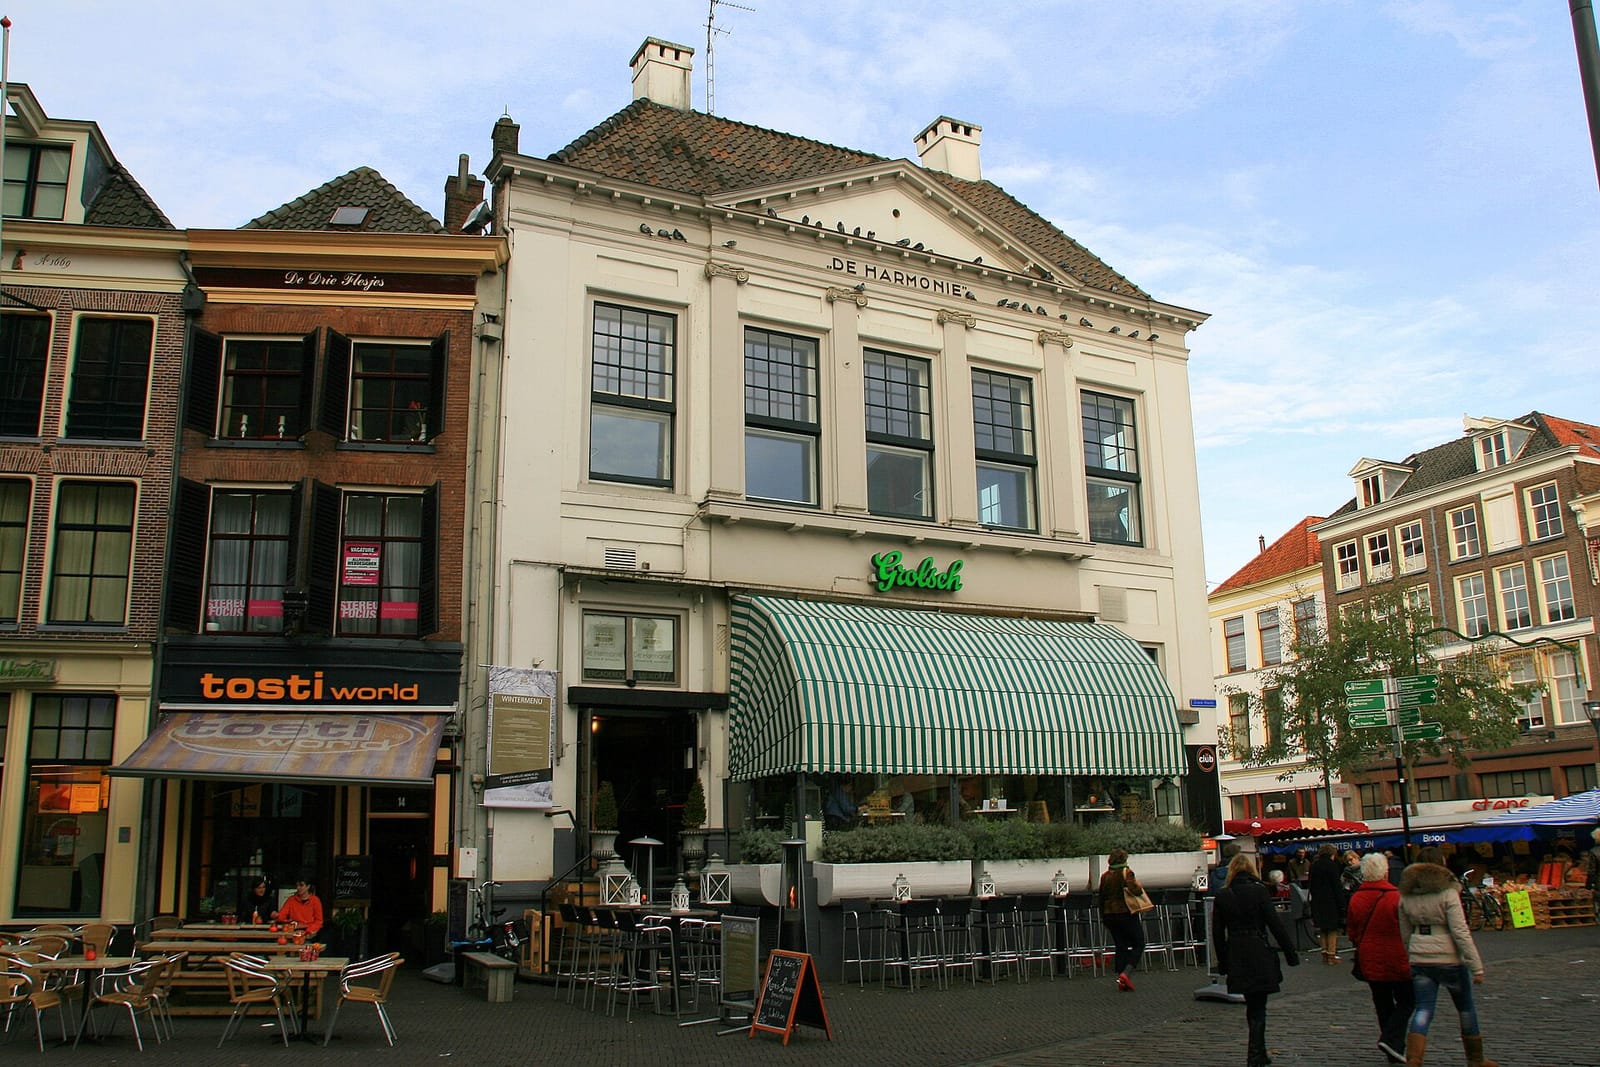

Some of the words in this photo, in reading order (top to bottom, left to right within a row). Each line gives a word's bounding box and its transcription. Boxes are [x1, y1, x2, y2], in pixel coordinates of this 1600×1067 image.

[49, 256, 72, 269] 1669
[284, 271, 304, 285] De
[308, 271, 338, 286] Drie
[341, 272, 385, 291] Flesjes
[871, 550, 964, 592] Grolsch
[208, 607, 244, 617] FOCUS
[342, 609, 377, 619] FOCUS
[200, 671, 324, 700] tosti
[330, 683, 418, 700] world
[502, 695, 543, 705] WINTERMENU
[184, 718, 371, 739] tosti
[256, 738, 392, 750] world
